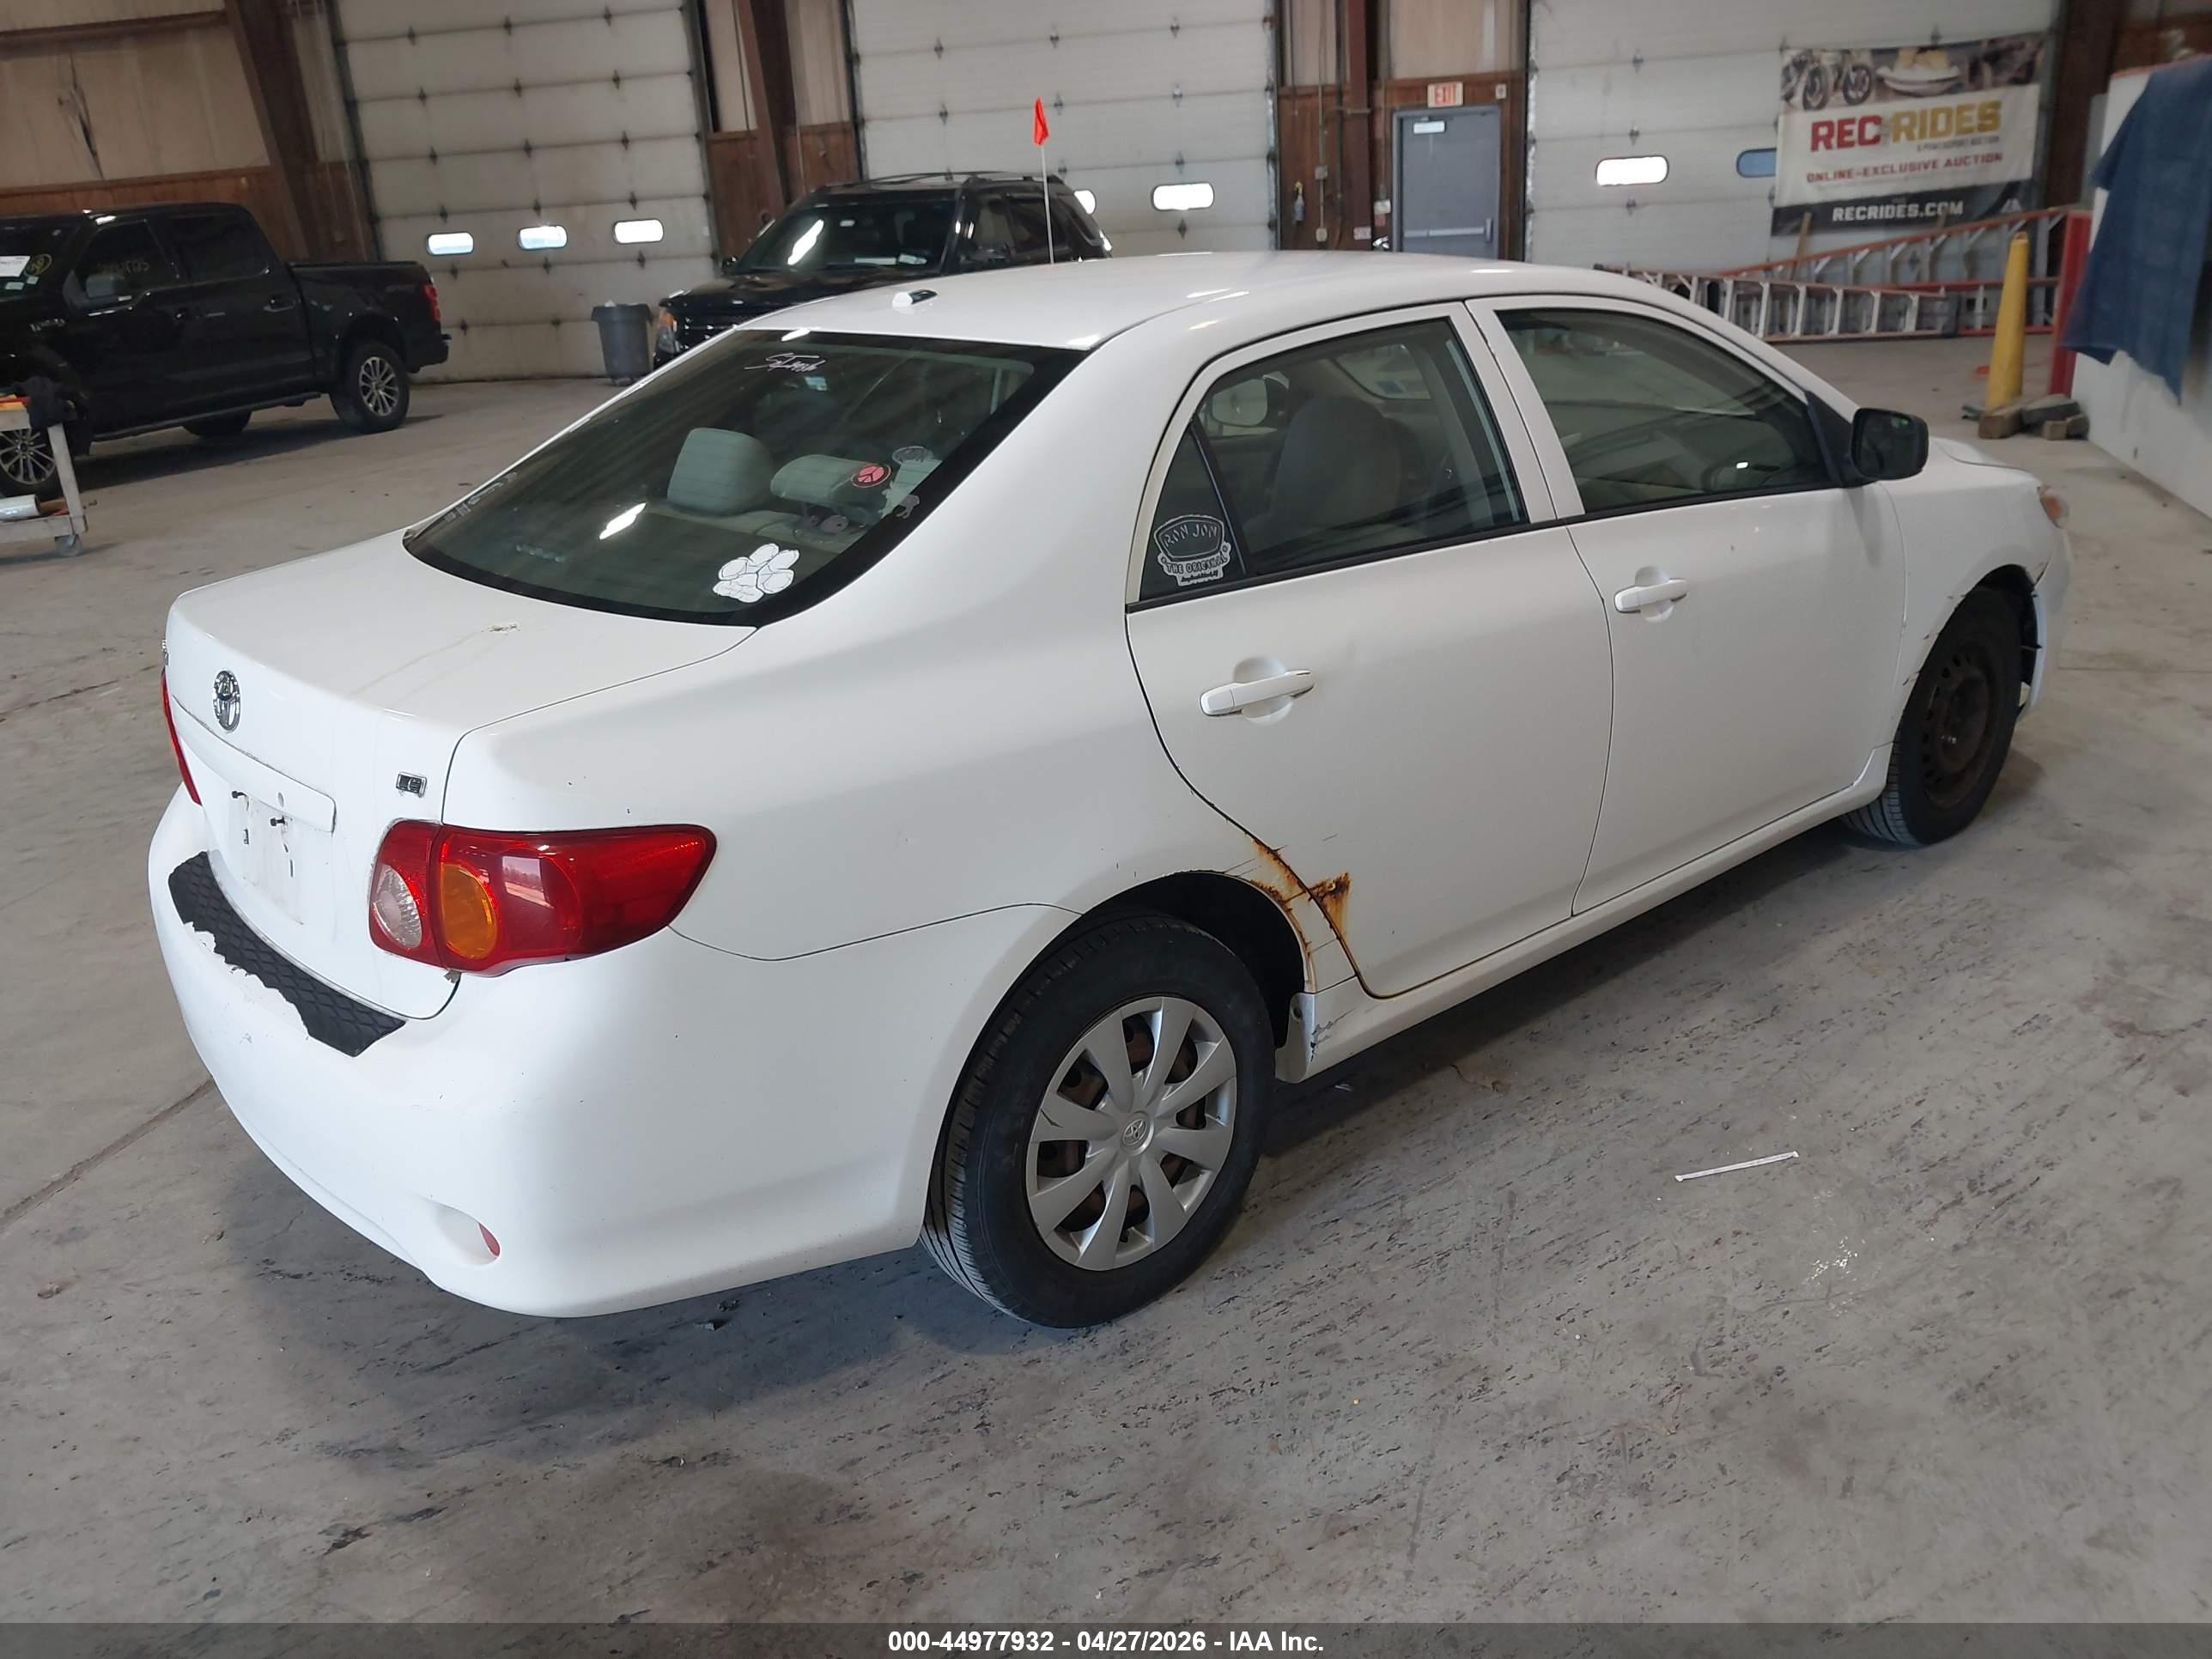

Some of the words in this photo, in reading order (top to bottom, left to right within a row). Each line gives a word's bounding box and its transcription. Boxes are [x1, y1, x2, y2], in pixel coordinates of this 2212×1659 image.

[1810, 114, 1883, 152] REC
[1891, 100, 2002, 143] RIDES
[1807, 160, 1938, 183] ONLINE-EXCLUSIVE
[1943, 152, 2003, 168] AUCTION
[1832, 201, 1964, 222] RECRIDES.COM
[1167, 562, 1183, 574] THE
